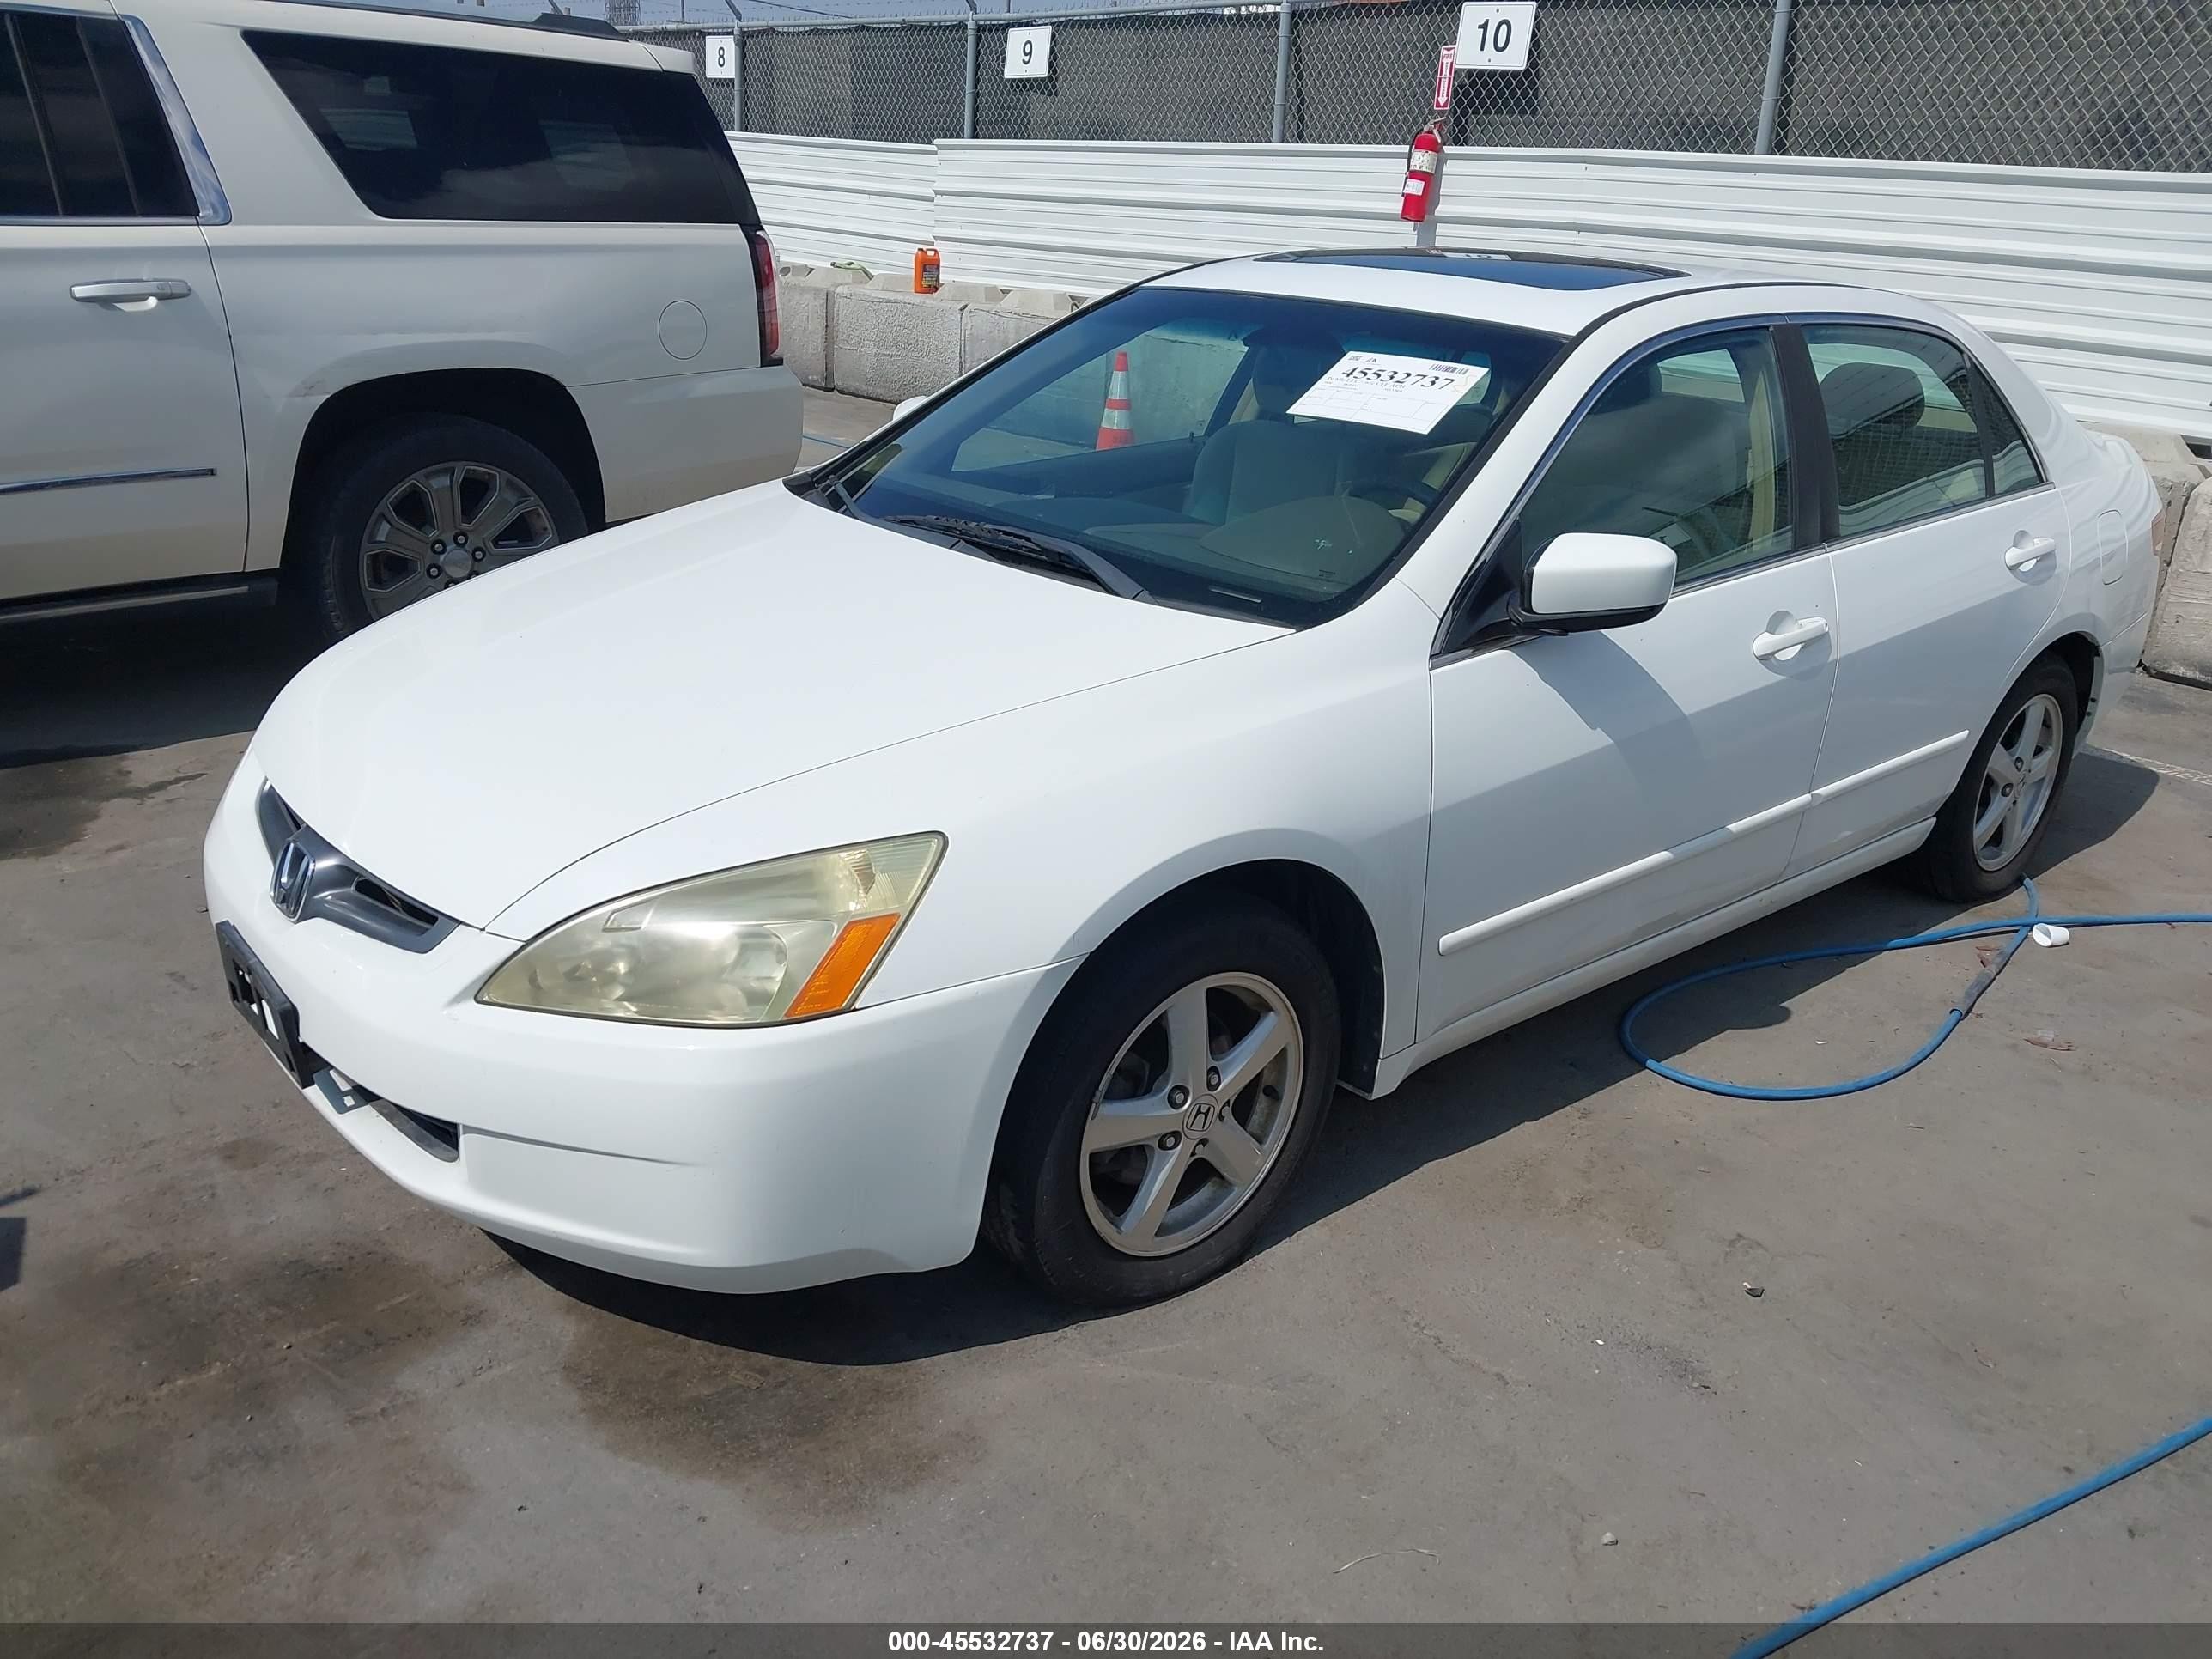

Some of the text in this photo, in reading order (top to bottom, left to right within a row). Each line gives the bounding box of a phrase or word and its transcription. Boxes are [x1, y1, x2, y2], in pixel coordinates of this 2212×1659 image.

[1477, 18, 1512, 53] 10
[717, 46, 726, 68] 8
[1022, 40, 1033, 65] 9
[1341, 366, 1457, 390] 45532737
